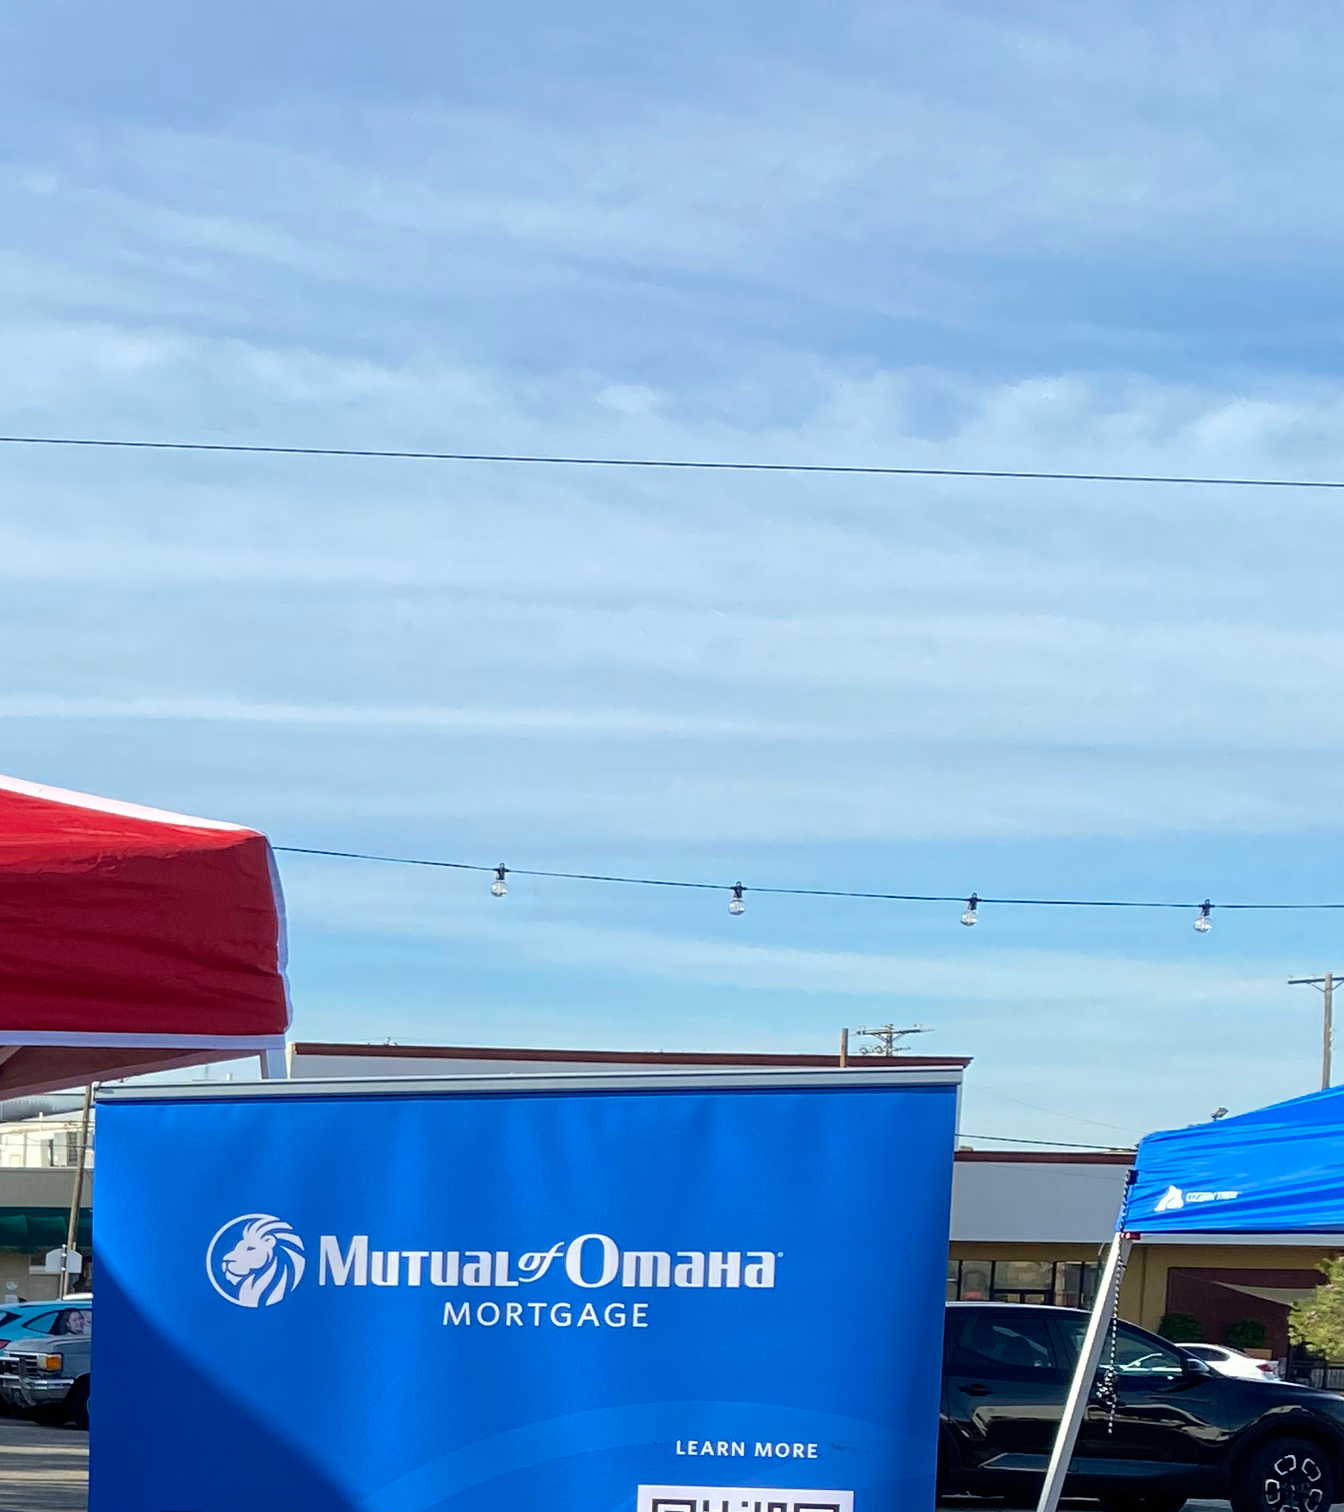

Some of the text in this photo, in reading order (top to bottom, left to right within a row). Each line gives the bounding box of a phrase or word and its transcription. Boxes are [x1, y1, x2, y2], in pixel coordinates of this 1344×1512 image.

[518, 1242, 564, 1283] of
[443, 1302, 648, 1327] MORTGAGE
[676, 1440, 818, 1458] LEARN MORE
